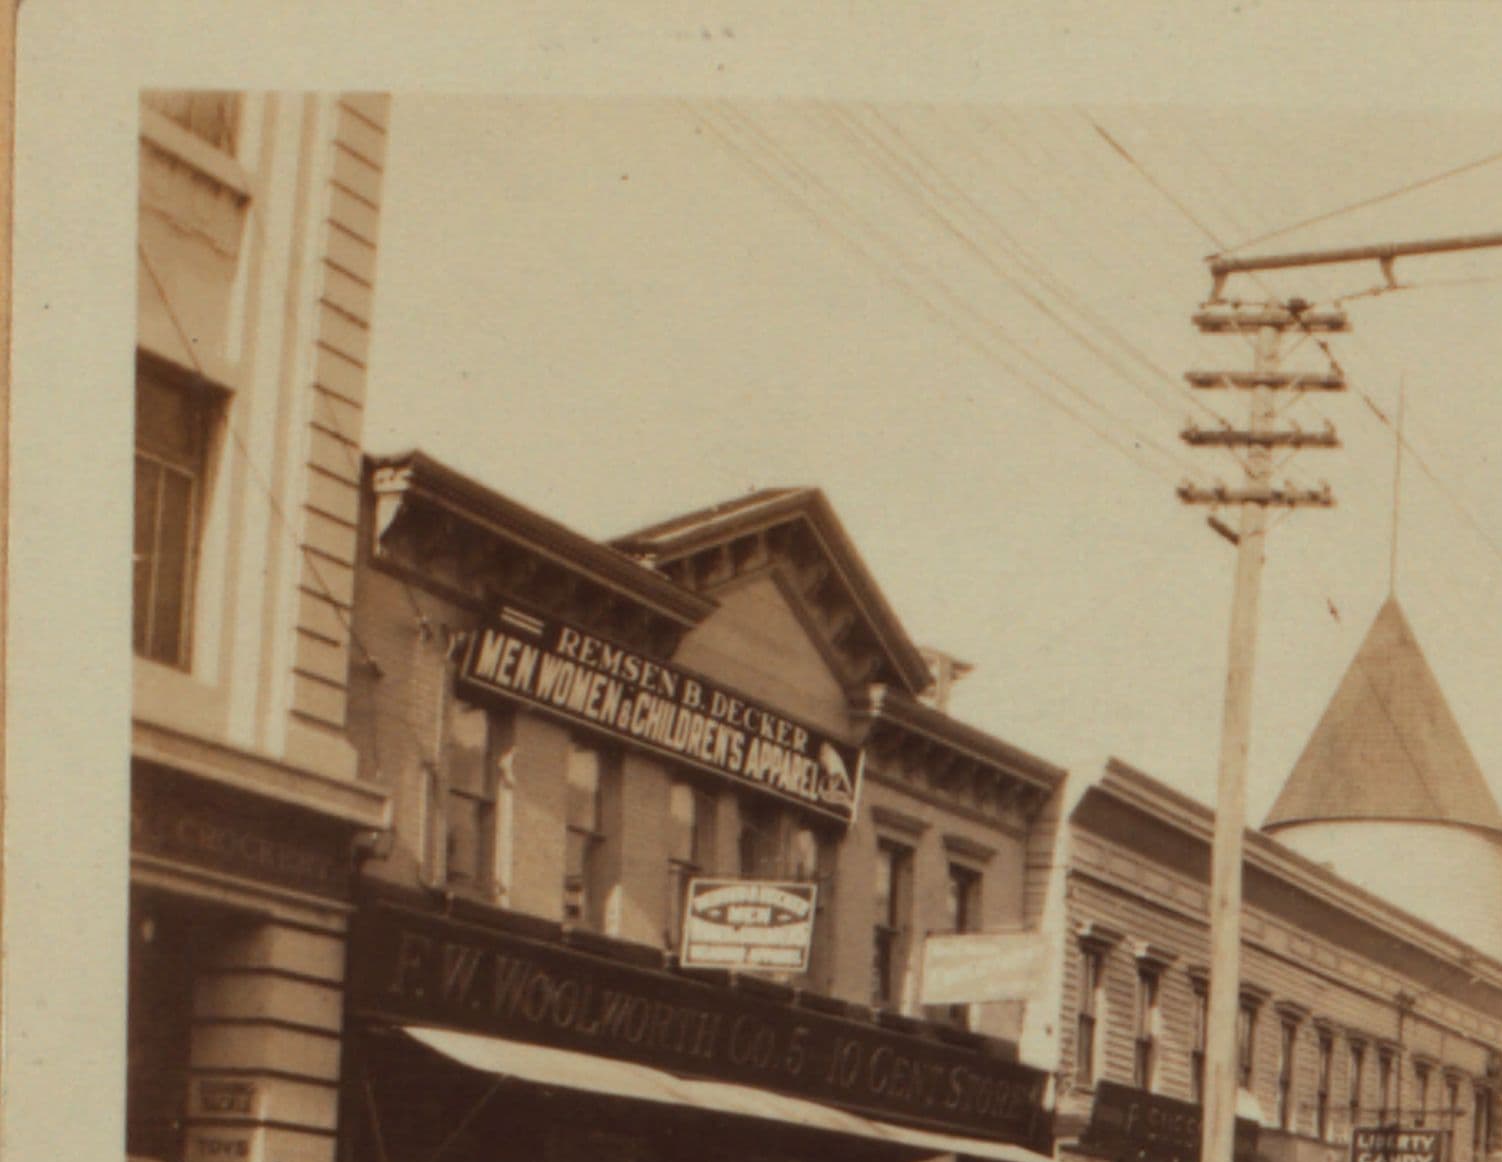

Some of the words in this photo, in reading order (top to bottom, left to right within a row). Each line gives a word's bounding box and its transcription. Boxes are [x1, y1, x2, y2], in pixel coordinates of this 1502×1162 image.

[535, 651, 624, 727] WOMEN
[617, 698, 633, 730] &
[630, 691, 745, 773] CHILDREN'S
[744, 736, 820, 802] APPAREL
[556, 626, 679, 697] REMSEN
[682, 680, 706, 711] B.
[710, 690, 810, 753] DECKER
[493, 951, 721, 1059] WOOLWORTH
[868, 1045, 944, 1107] CENT
[943, 1064, 1025, 1120] STORE
[1358, 1133, 1435, 1151] LIBERTY
